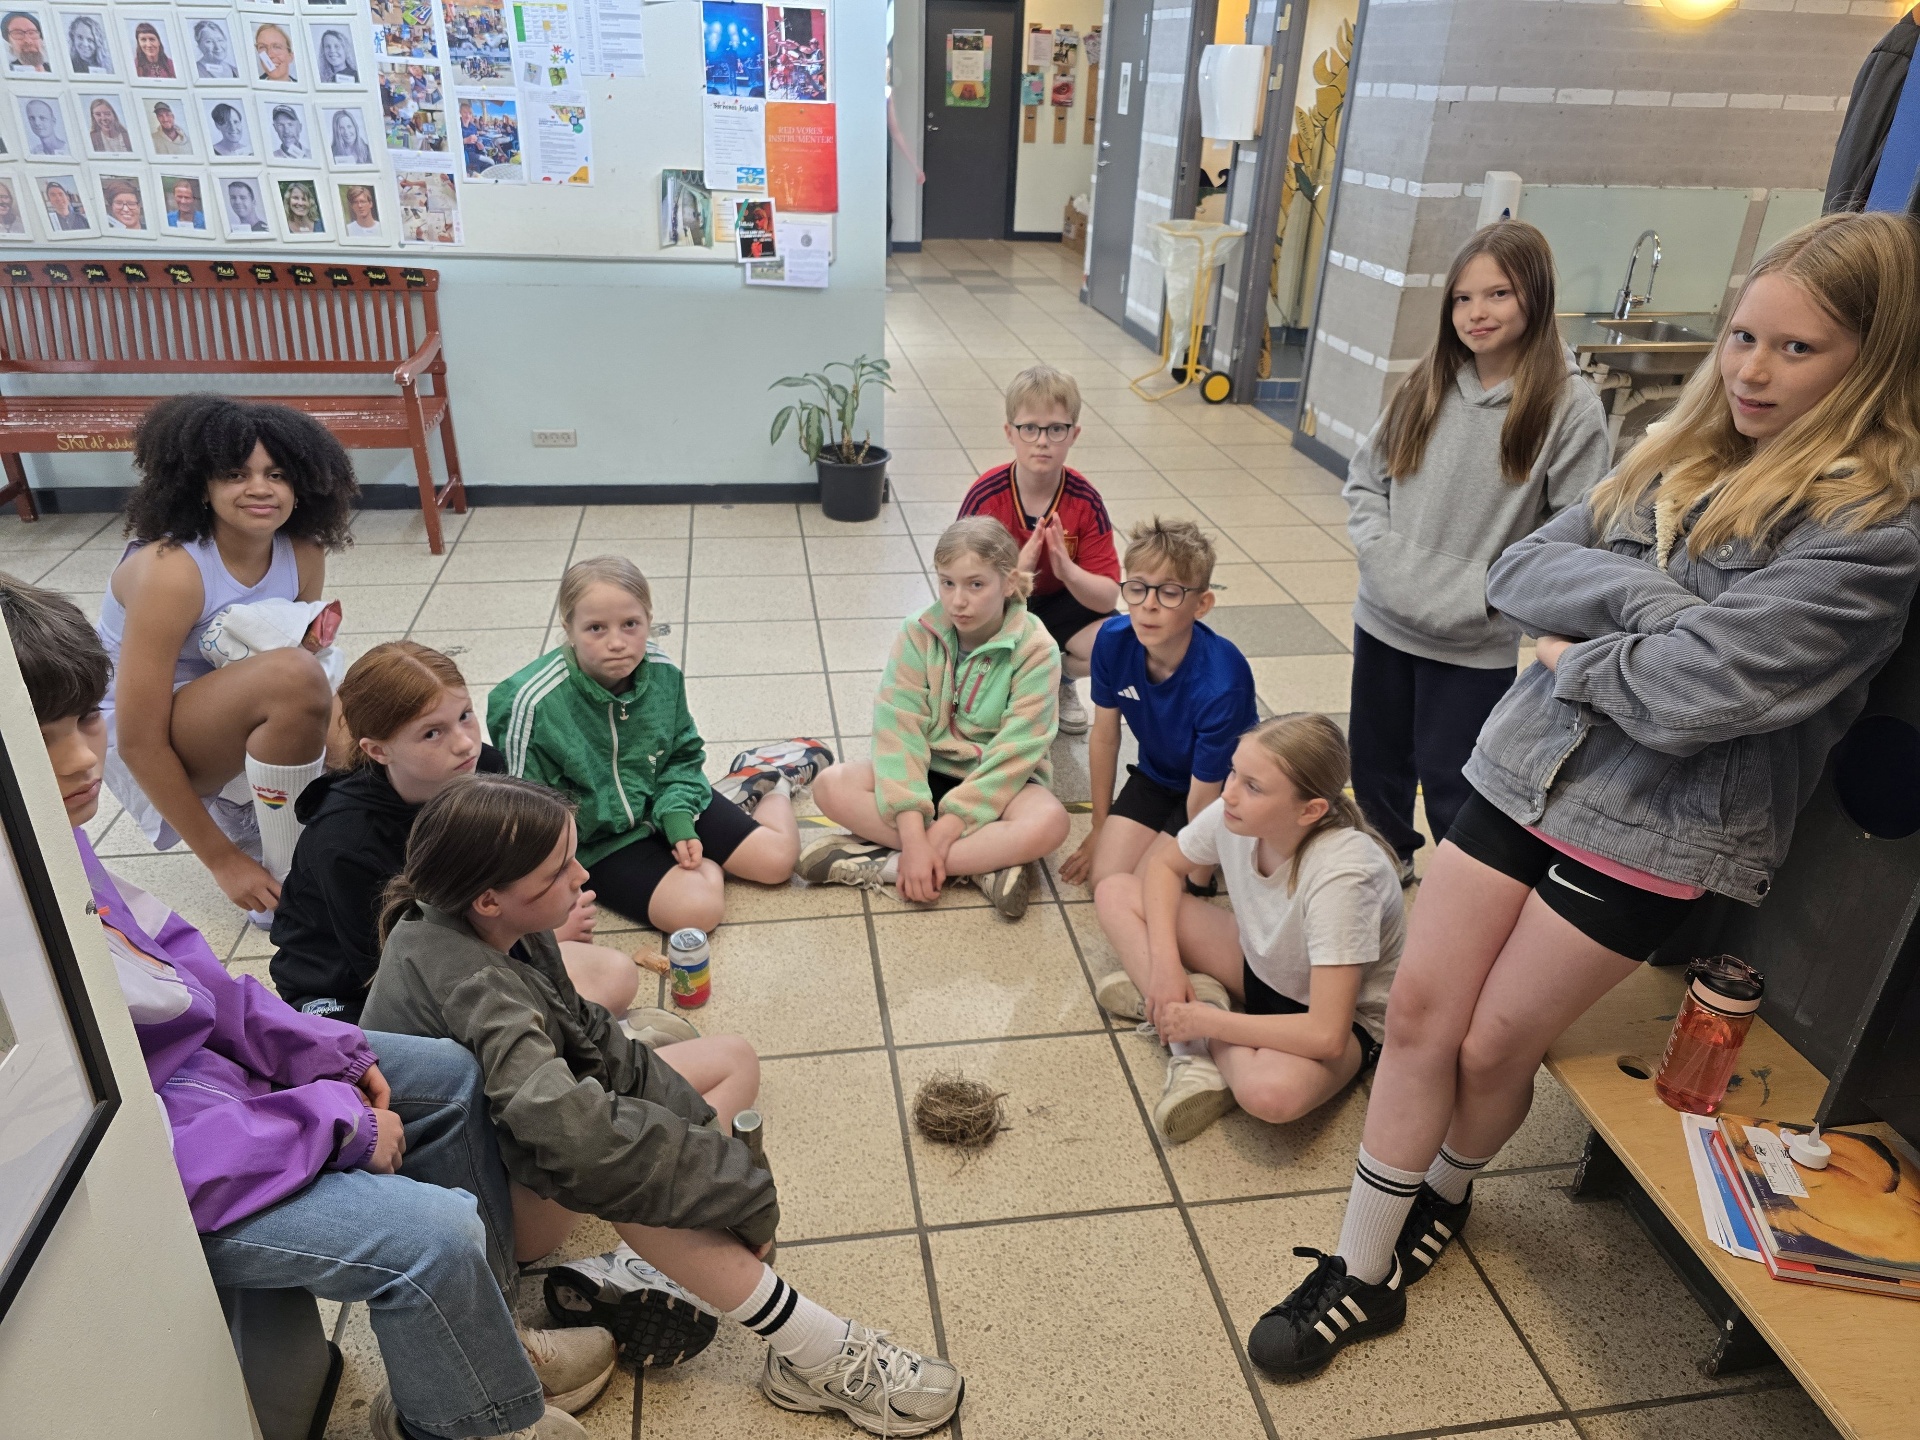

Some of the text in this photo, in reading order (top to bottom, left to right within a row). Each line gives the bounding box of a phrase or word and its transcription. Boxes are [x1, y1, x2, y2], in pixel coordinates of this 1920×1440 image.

[778, 126, 795, 134] RED
[768, 135, 834, 143] INSTRUMENTER!
[217, 266, 235, 276] Mads
[252, 784, 288, 796] LOVE
